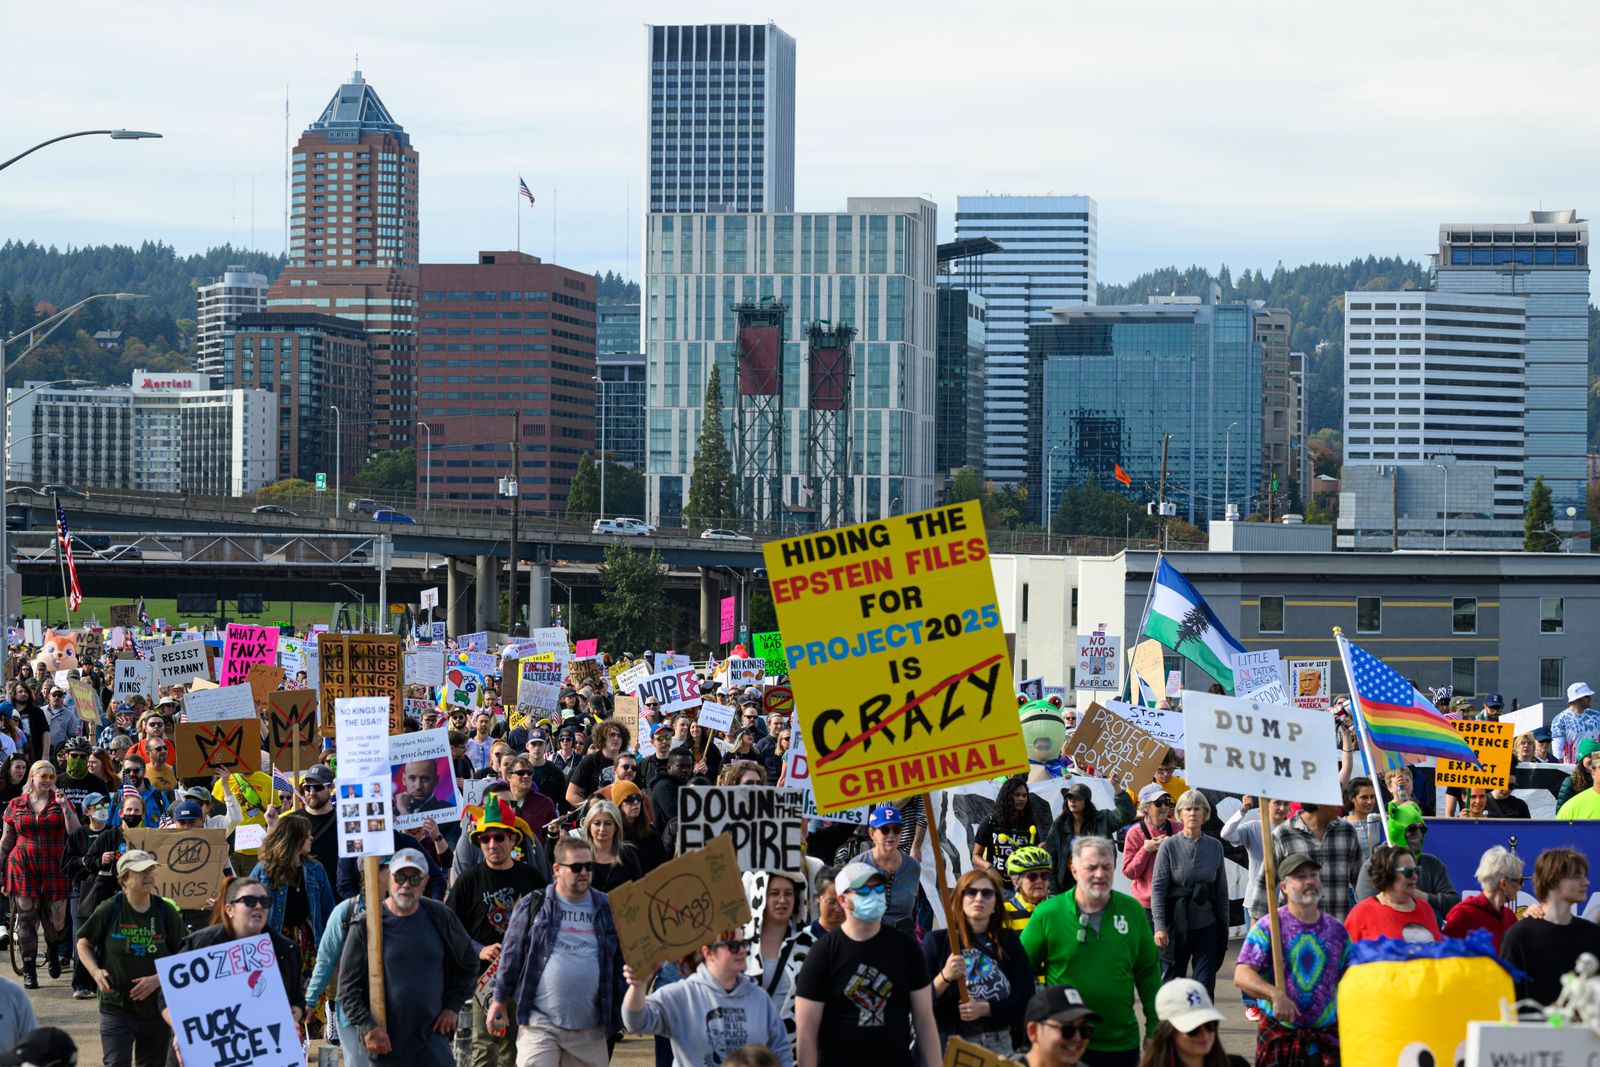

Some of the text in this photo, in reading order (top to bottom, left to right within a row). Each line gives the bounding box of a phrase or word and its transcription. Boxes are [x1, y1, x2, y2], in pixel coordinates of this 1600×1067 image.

[141, 378, 191, 389] Marriott
[781, 508, 966, 567] HIDING THE
[772, 538, 986, 604] EPSTEIN FILES
[860, 585, 924, 618] FOR
[230, 628, 267, 641] WHAT A
[786, 604, 1000, 670] PROJECT2025
[1089, 637, 1105, 645] NO
[162, 649, 199, 662] RESIST
[231, 642, 273, 658] FAUX-
[324, 644, 343, 654] NO
[350, 644, 396, 656] KINGS
[1081, 647, 1115, 658] KINGS
[326, 659, 344, 669] NO
[351, 659, 396, 670] KINGS
[731, 659, 764, 669] NO KINGS
[1239, 652, 1268, 666] LITTLE
[124, 667, 135, 678] NO
[161, 662, 205, 677] TYRANNY
[228, 660, 266, 674] KIN
[888, 657, 922, 684] IS
[326, 673, 396, 685] NO KINGS
[731, 671, 741, 680] NO
[119, 682, 140, 693] KINGS
[326, 688, 396, 700] NO KINGS
[1250, 684, 1286, 704] EEDOM
[812, 663, 1002, 760] CRAZY
[1130, 707, 1165, 718] STOP
[1215, 710, 1303, 742] DUMP
[1451, 722, 1503, 734] RESPECT
[1092, 709, 1165, 759] PROTECT
[1146, 731, 1185, 740] CIDE!
[393, 740, 416, 748] Stephen
[1464, 736, 1509, 748] STENCE
[400, 744, 446, 761] psychopath
[1097, 731, 1144, 767] PEOPLE
[1101, 749, 1128, 768] NOT
[1199, 743, 1317, 781] TRUMP
[839, 744, 1006, 797] CRIMINAL
[1073, 742, 1134, 790] POWER
[1449, 761, 1496, 773] EXPECT
[1437, 773, 1505, 786] RESISTANCE
[680, 788, 803, 823] DOWN WITH
[775, 805, 802, 819] THE
[421, 811, 440, 820] hates
[441, 808, 458, 819] you!
[885, 810, 894, 819] P
[560, 910, 593, 923] RTLAN
[656, 892, 710, 936] Kings
[121, 927, 150, 935] earth
[132, 934, 152, 946] day
[182, 1004, 250, 1045] FUCK
[210, 1022, 281, 1067] ICE!
